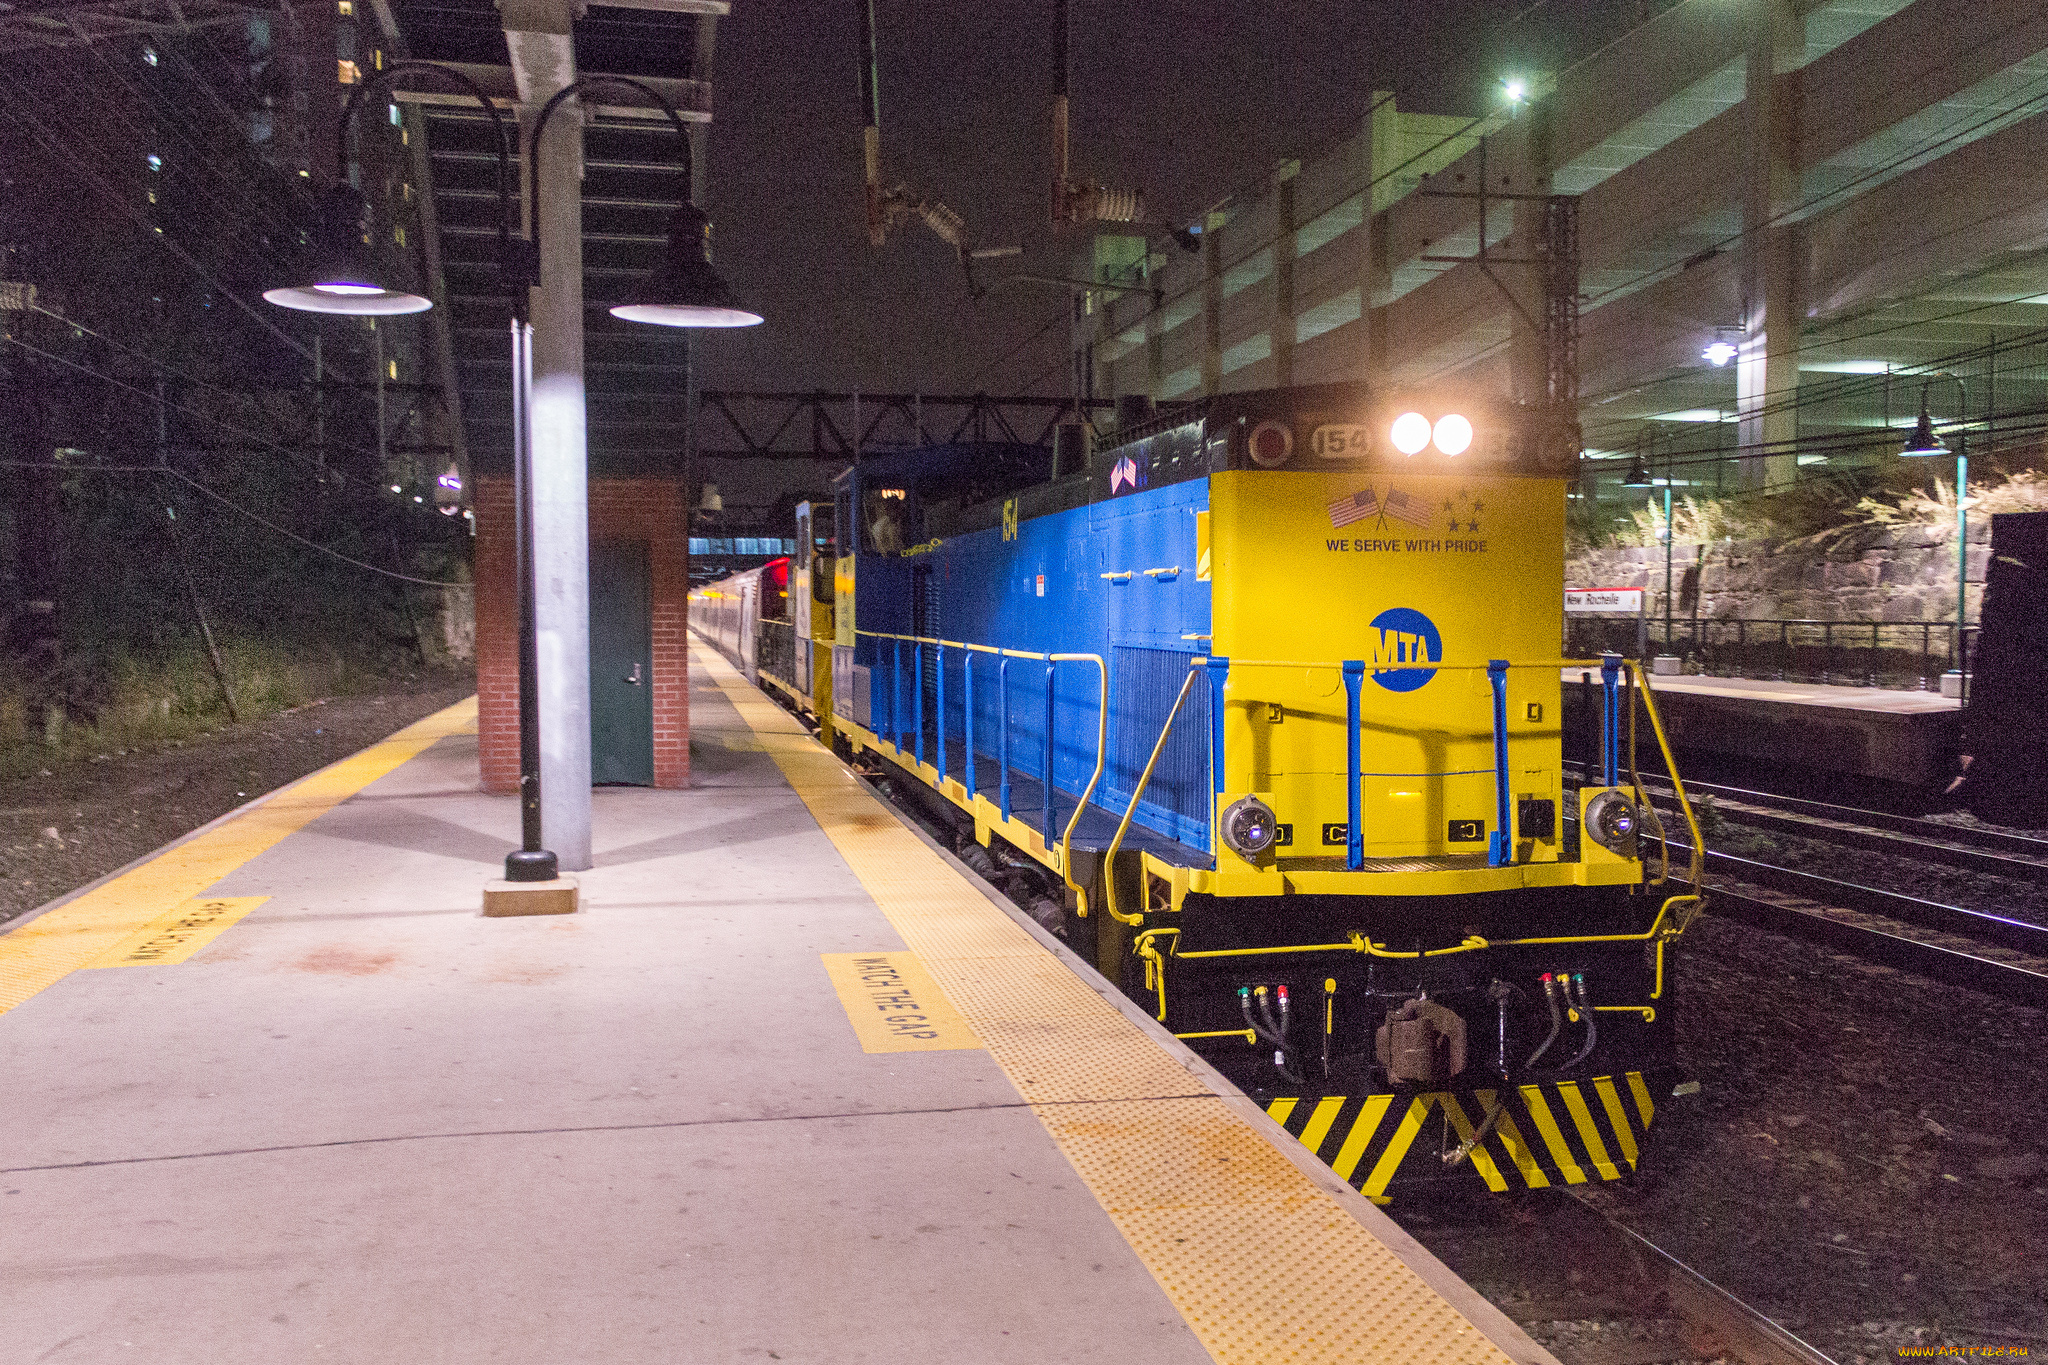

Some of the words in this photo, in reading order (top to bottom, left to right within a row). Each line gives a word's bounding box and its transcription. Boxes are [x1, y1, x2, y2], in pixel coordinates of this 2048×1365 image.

[1317, 430, 1367, 453] 154
[1326, 539, 1352, 552] WE
[1354, 539, 1400, 552] SERVE
[1405, 540, 1441, 552] WITH
[1445, 540, 1487, 552] PRIDE
[1367, 626, 1429, 674] MTA
[851, 957, 904, 988] WATCH
[871, 989, 920, 1011] THE
[886, 1014, 938, 1040] GAP
